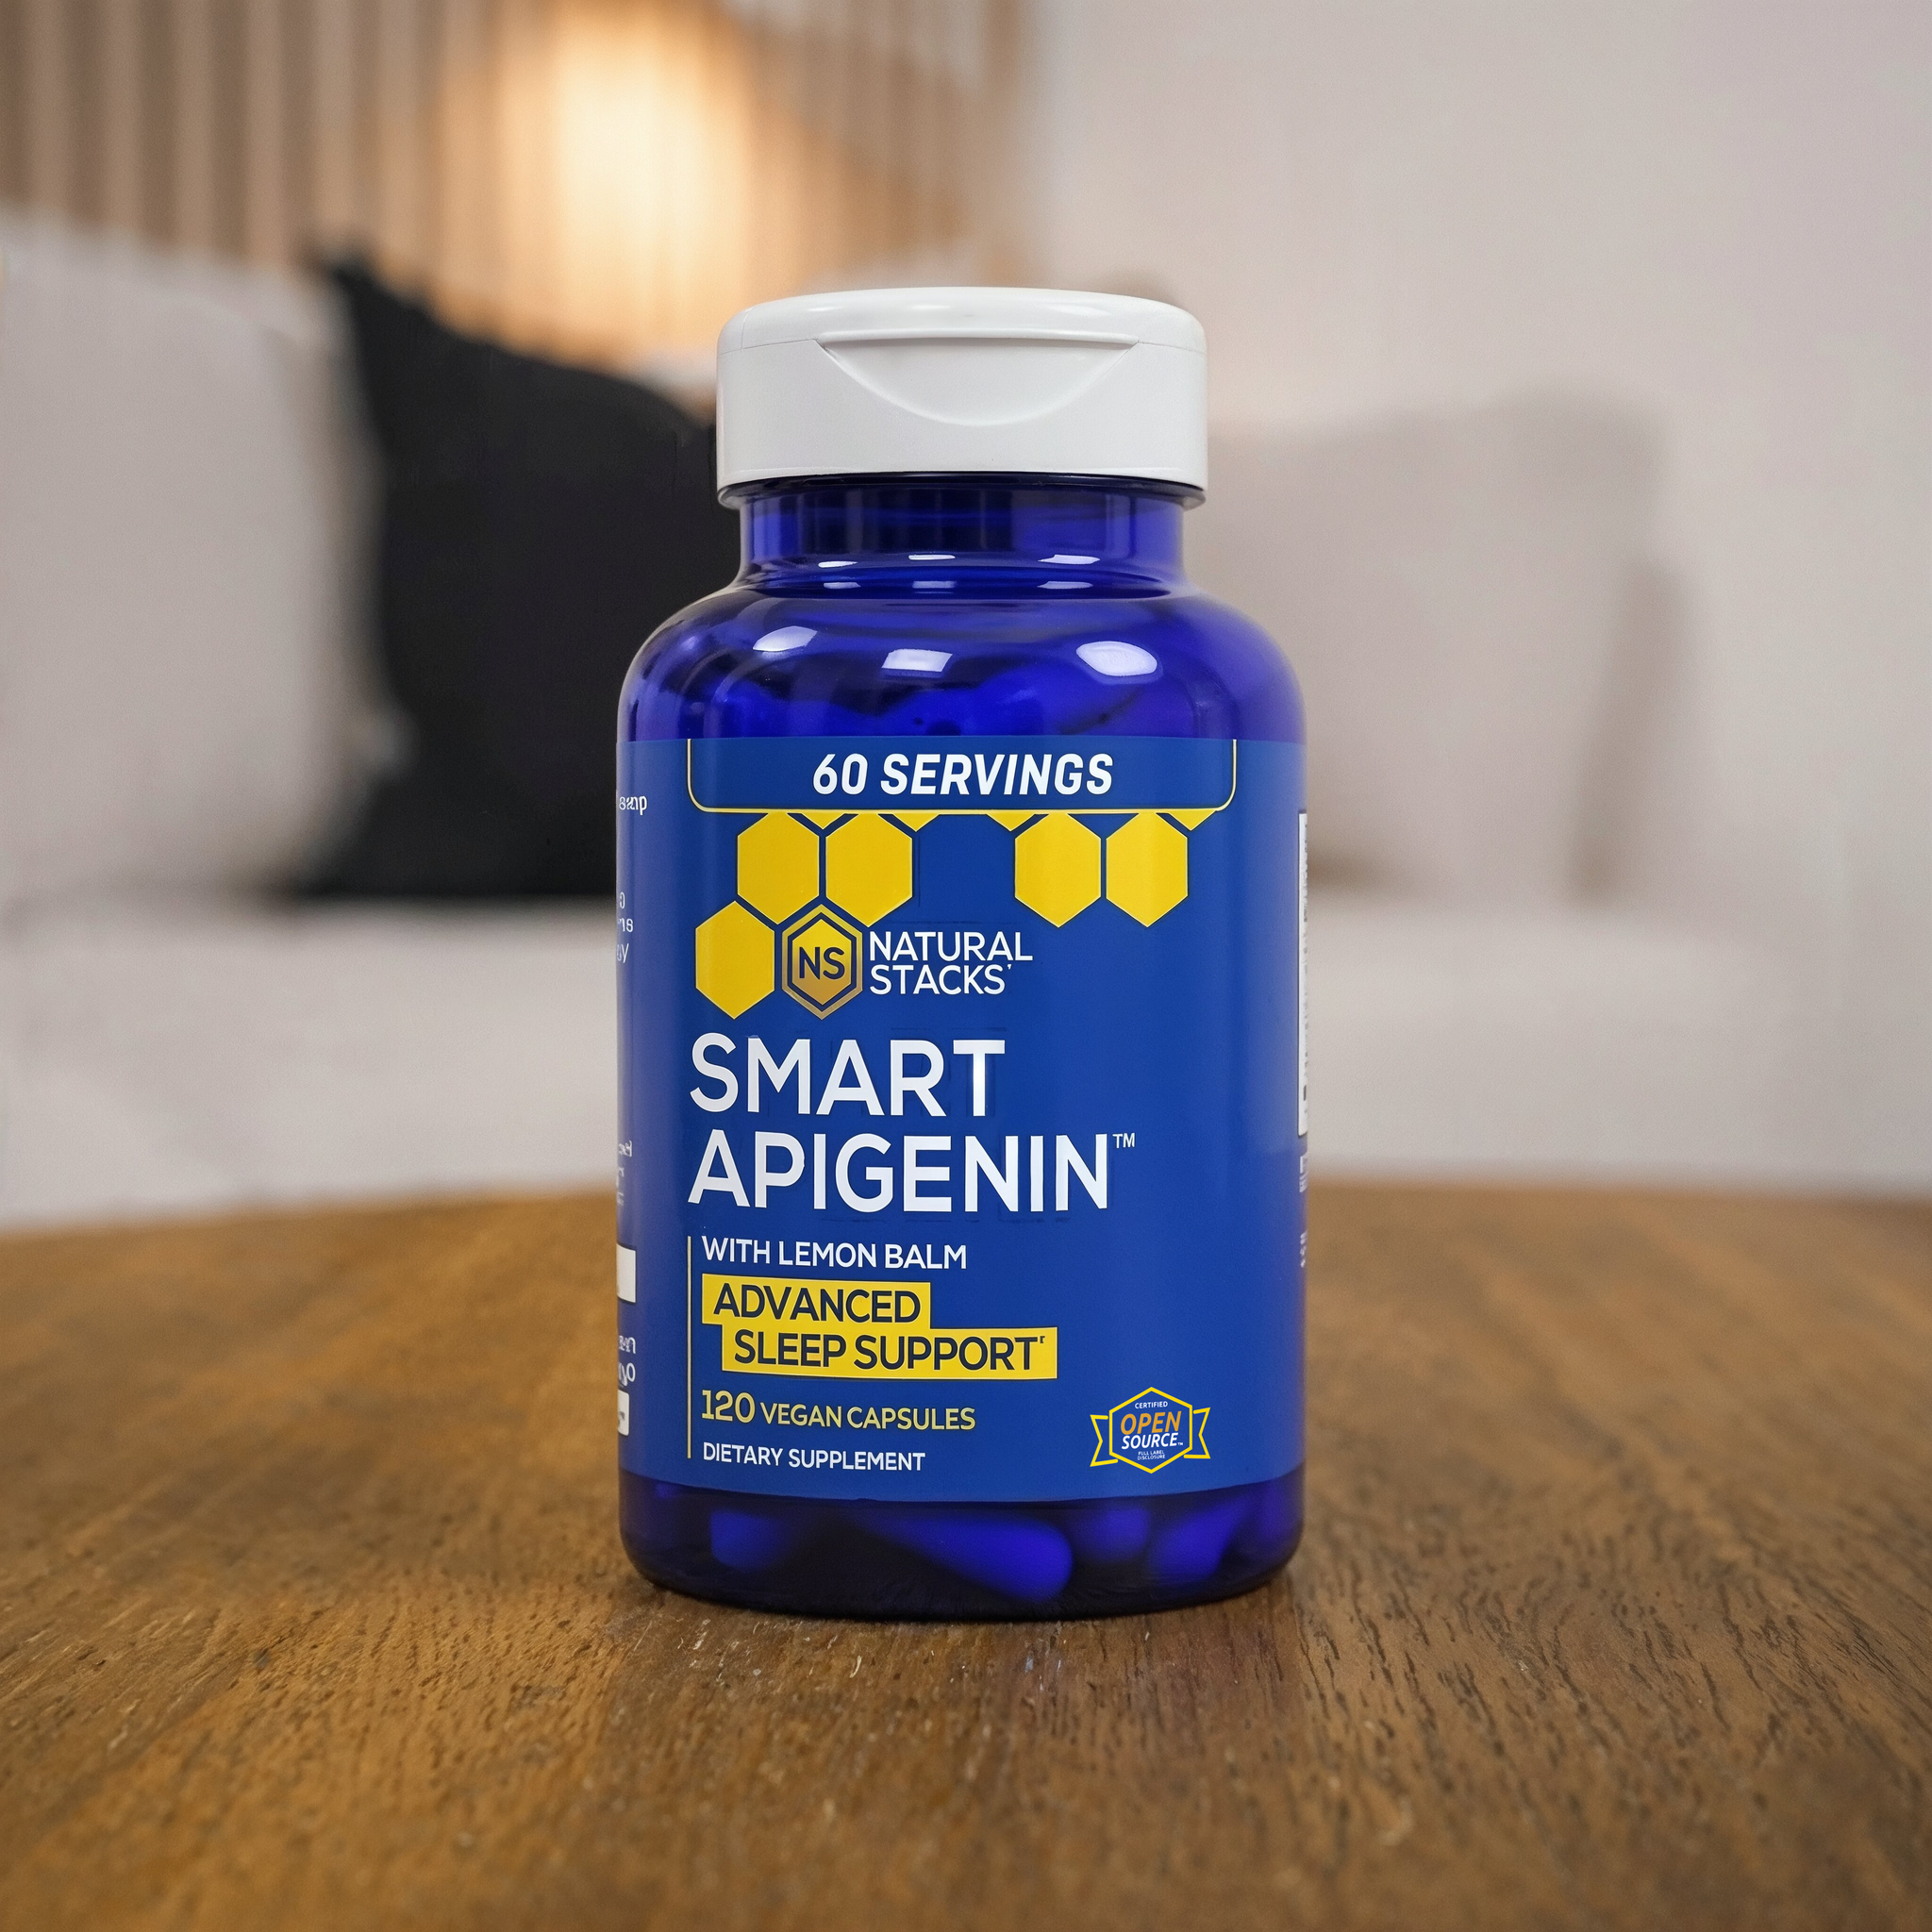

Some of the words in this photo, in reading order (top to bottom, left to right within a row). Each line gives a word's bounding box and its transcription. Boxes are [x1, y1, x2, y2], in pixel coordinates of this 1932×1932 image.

[812, 754, 868, 795] 60
[880, 754, 1113, 795] SERVINGS
[798, 947, 846, 980] NS
[869, 931, 1033, 960] NATURAL
[690, 1032, 1008, 1117] SMART
[702, 1235, 771, 1264] WITH
[778, 1241, 876, 1268] LEMON
[885, 1243, 967, 1270] BALM
[713, 1282, 922, 1324] ADVANCED
[734, 1328, 846, 1368] SLEEP
[701, 1390, 756, 1424] 120
[759, 1402, 842, 1429] VEGAN
[846, 1407, 976, 1431] CAPSULES
[1120, 1410, 1182, 1436] OPEN
[703, 1442, 783, 1466] DIETARY
[788, 1448, 926, 1472] SUPPLEMENT
